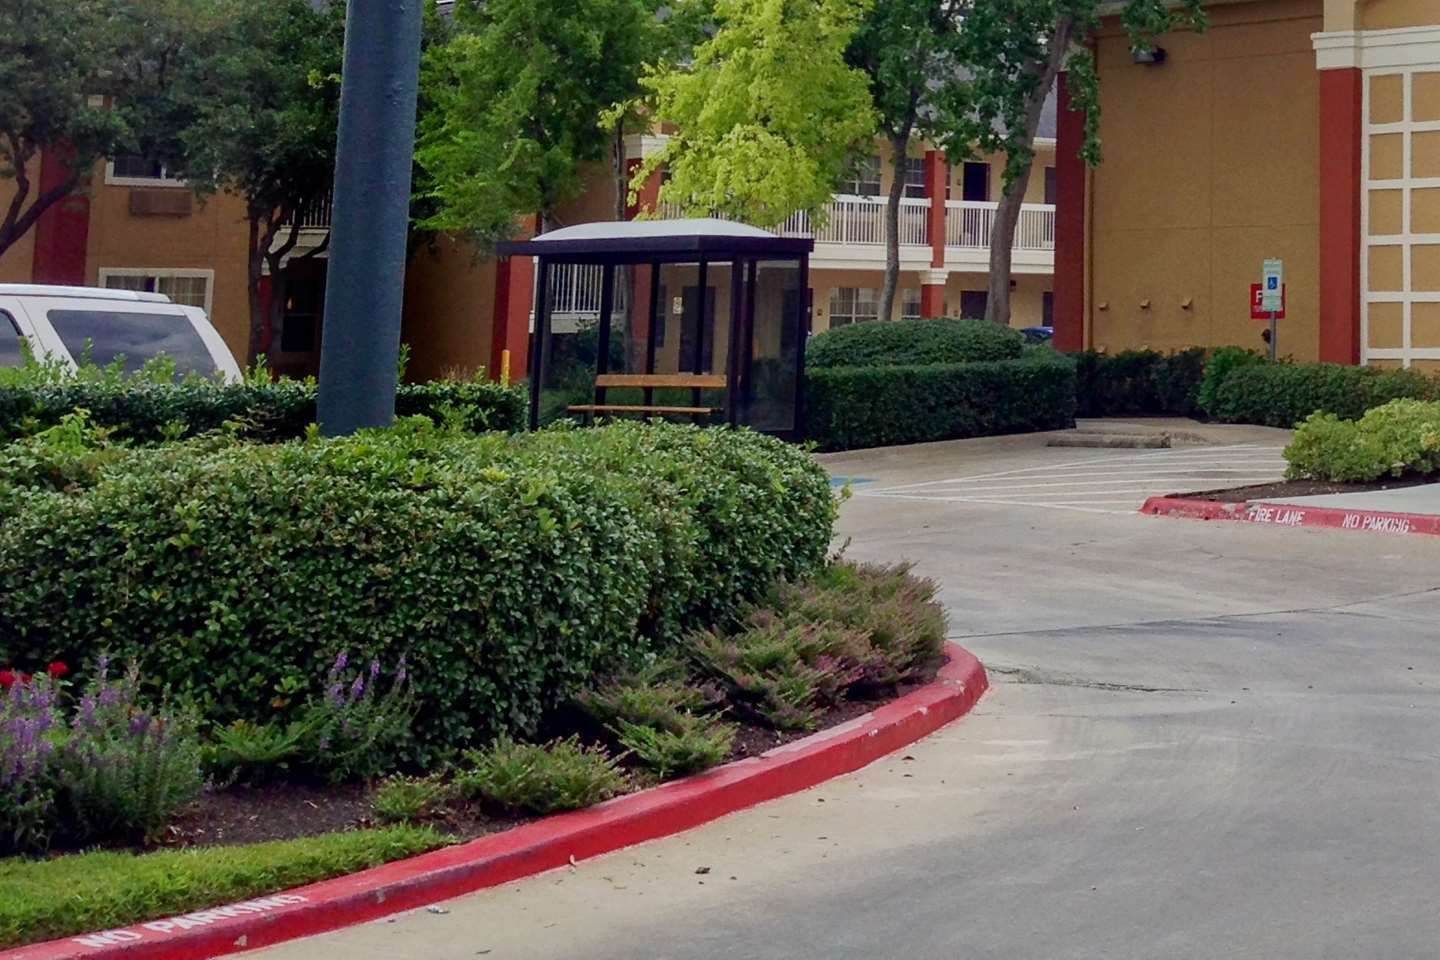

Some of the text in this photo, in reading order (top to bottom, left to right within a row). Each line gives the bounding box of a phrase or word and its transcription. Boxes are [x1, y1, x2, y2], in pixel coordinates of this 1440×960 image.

[1249, 507, 1306, 526] FIRE LANE
[1342, 513, 1410, 533] NO PARKING
[74, 894, 309, 947] NO PARKING
